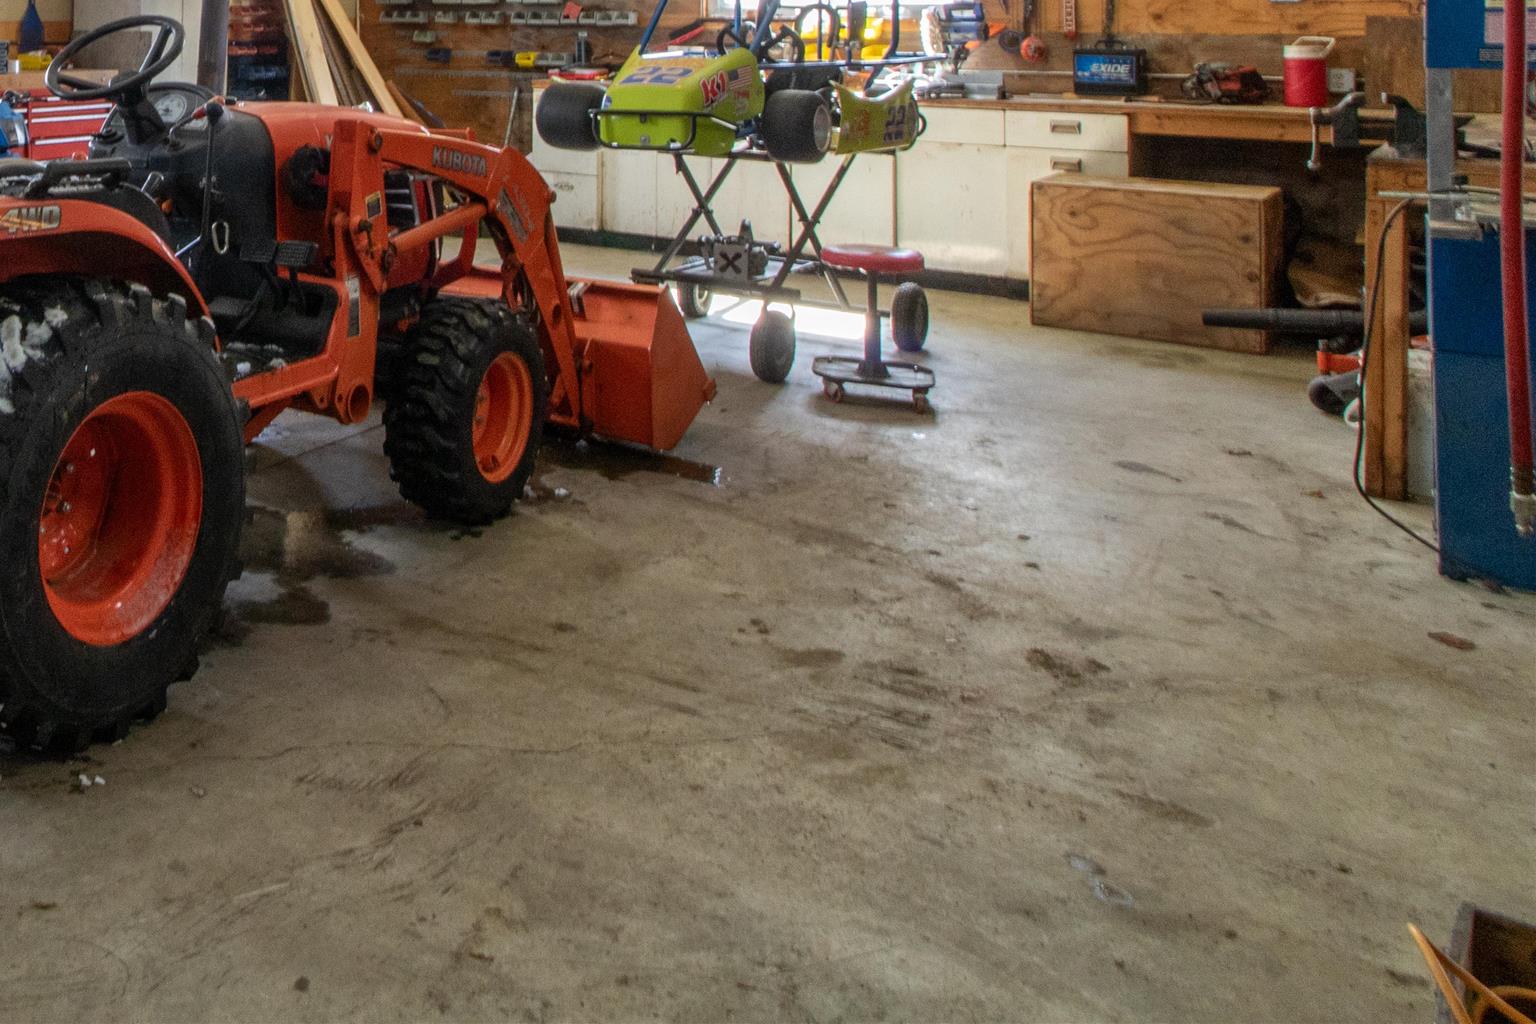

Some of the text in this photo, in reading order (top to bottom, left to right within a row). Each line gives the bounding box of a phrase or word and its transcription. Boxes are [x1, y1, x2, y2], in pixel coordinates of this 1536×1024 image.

[620, 66, 695, 86] 22
[1090, 63, 1133, 74] EXIDE
[700, 70, 727, 106] K1
[432, 144, 487, 176] KUBOTA
